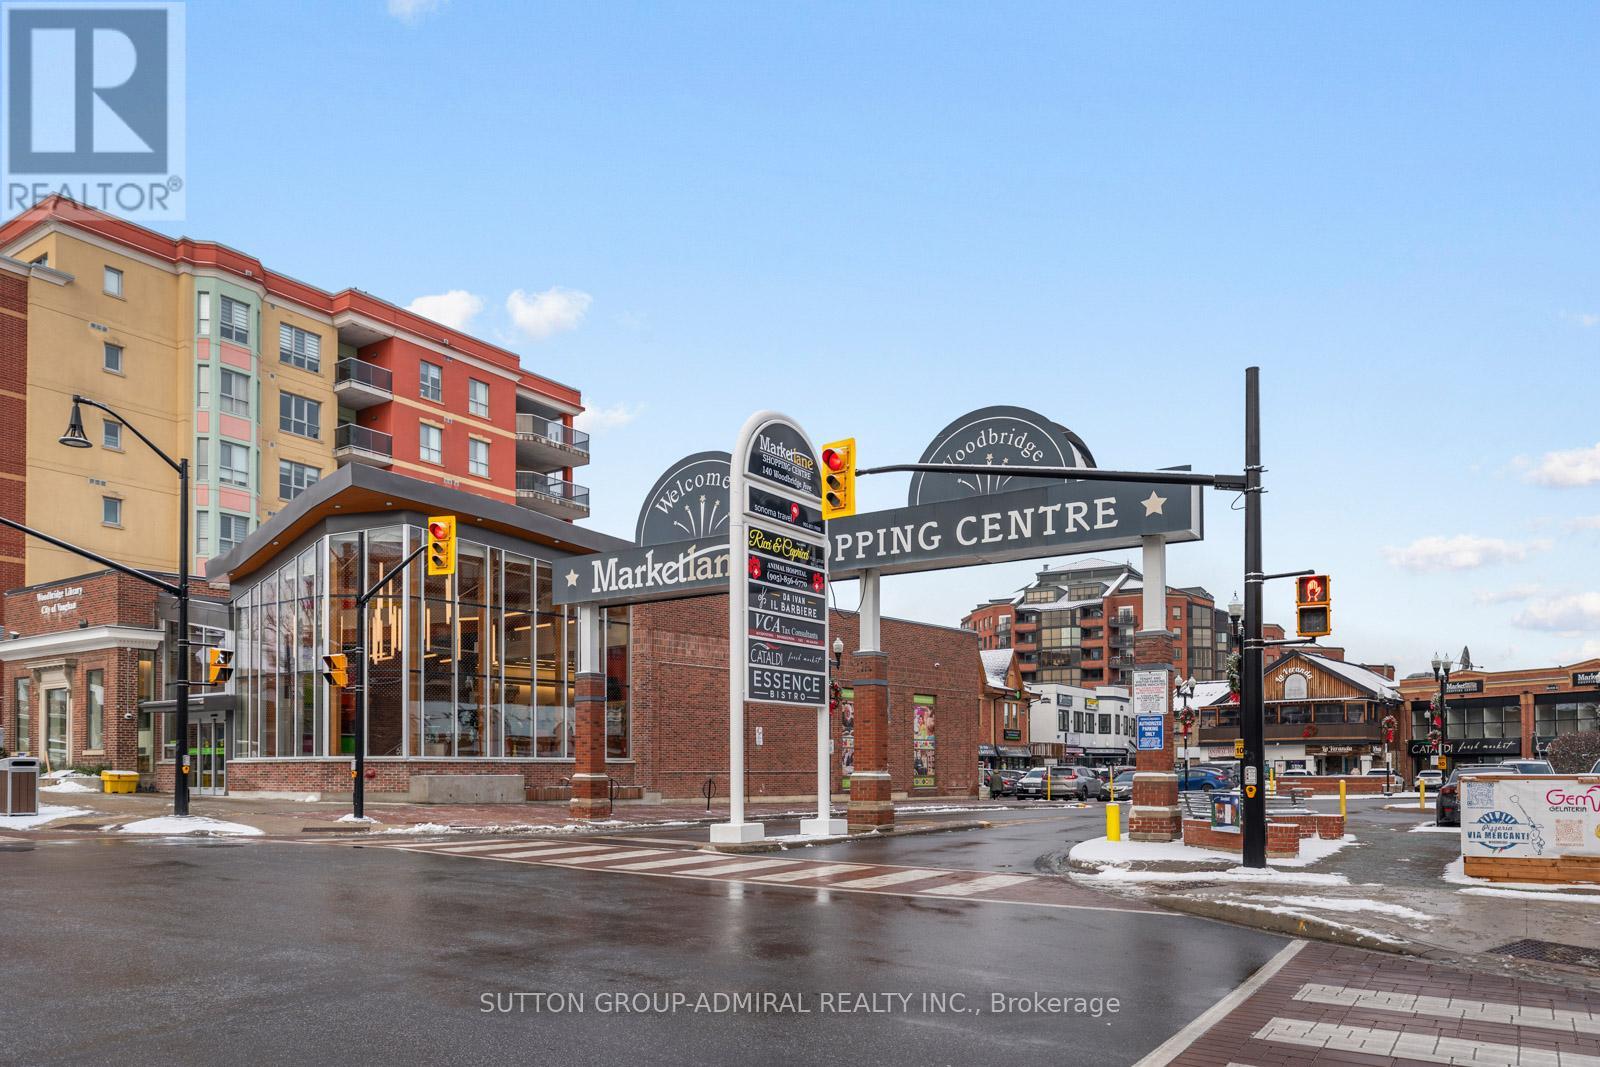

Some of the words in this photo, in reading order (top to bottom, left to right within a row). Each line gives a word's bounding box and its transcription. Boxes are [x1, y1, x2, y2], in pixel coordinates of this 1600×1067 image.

[760, 434, 814, 471] Marketlane
[762, 453, 792, 472] SHOPPING
[792, 465, 812, 481] CENTRE
[762, 465, 773, 476] 140
[773, 469, 802, 489] Woodbridge
[655, 472, 730, 515] Welcome
[754, 504, 777, 516] sonoma
[777, 511, 793, 522] travel
[826, 521, 942, 562] PPING
[956, 497, 1119, 546] CENTRE
[749, 529, 772, 550] Ricci
[773, 537, 782, 553] &
[782, 537, 810, 562] Capricci
[592, 544, 730, 594] Marketlan
[767, 562, 785, 572] ANIMAL
[785, 566, 807, 577] HOSPITAL
[37, 590, 64, 601] Woodbridge
[65, 587, 82, 597] Library
[782, 593, 791, 602] DA
[792, 595, 806, 604] IVAN
[41, 605, 51, 614] City
[57, 602, 77, 612] Vaughan
[770, 600, 779, 610] IL
[781, 602, 817, 618] BARBIERE
[755, 613, 780, 633] VCA
[781, 626, 791, 634] Tax
[791, 628, 818, 640] Consultants
[751, 648, 783, 666] CATALDI
[753, 670, 820, 692] ESSENCE
[769, 690, 806, 700] BISTRO
[1411, 744, 1453, 754] CATADI
[1457, 741, 1479, 752] fresh
[1481, 740, 1516, 751] market
[1467, 831, 1482, 839] VIA
